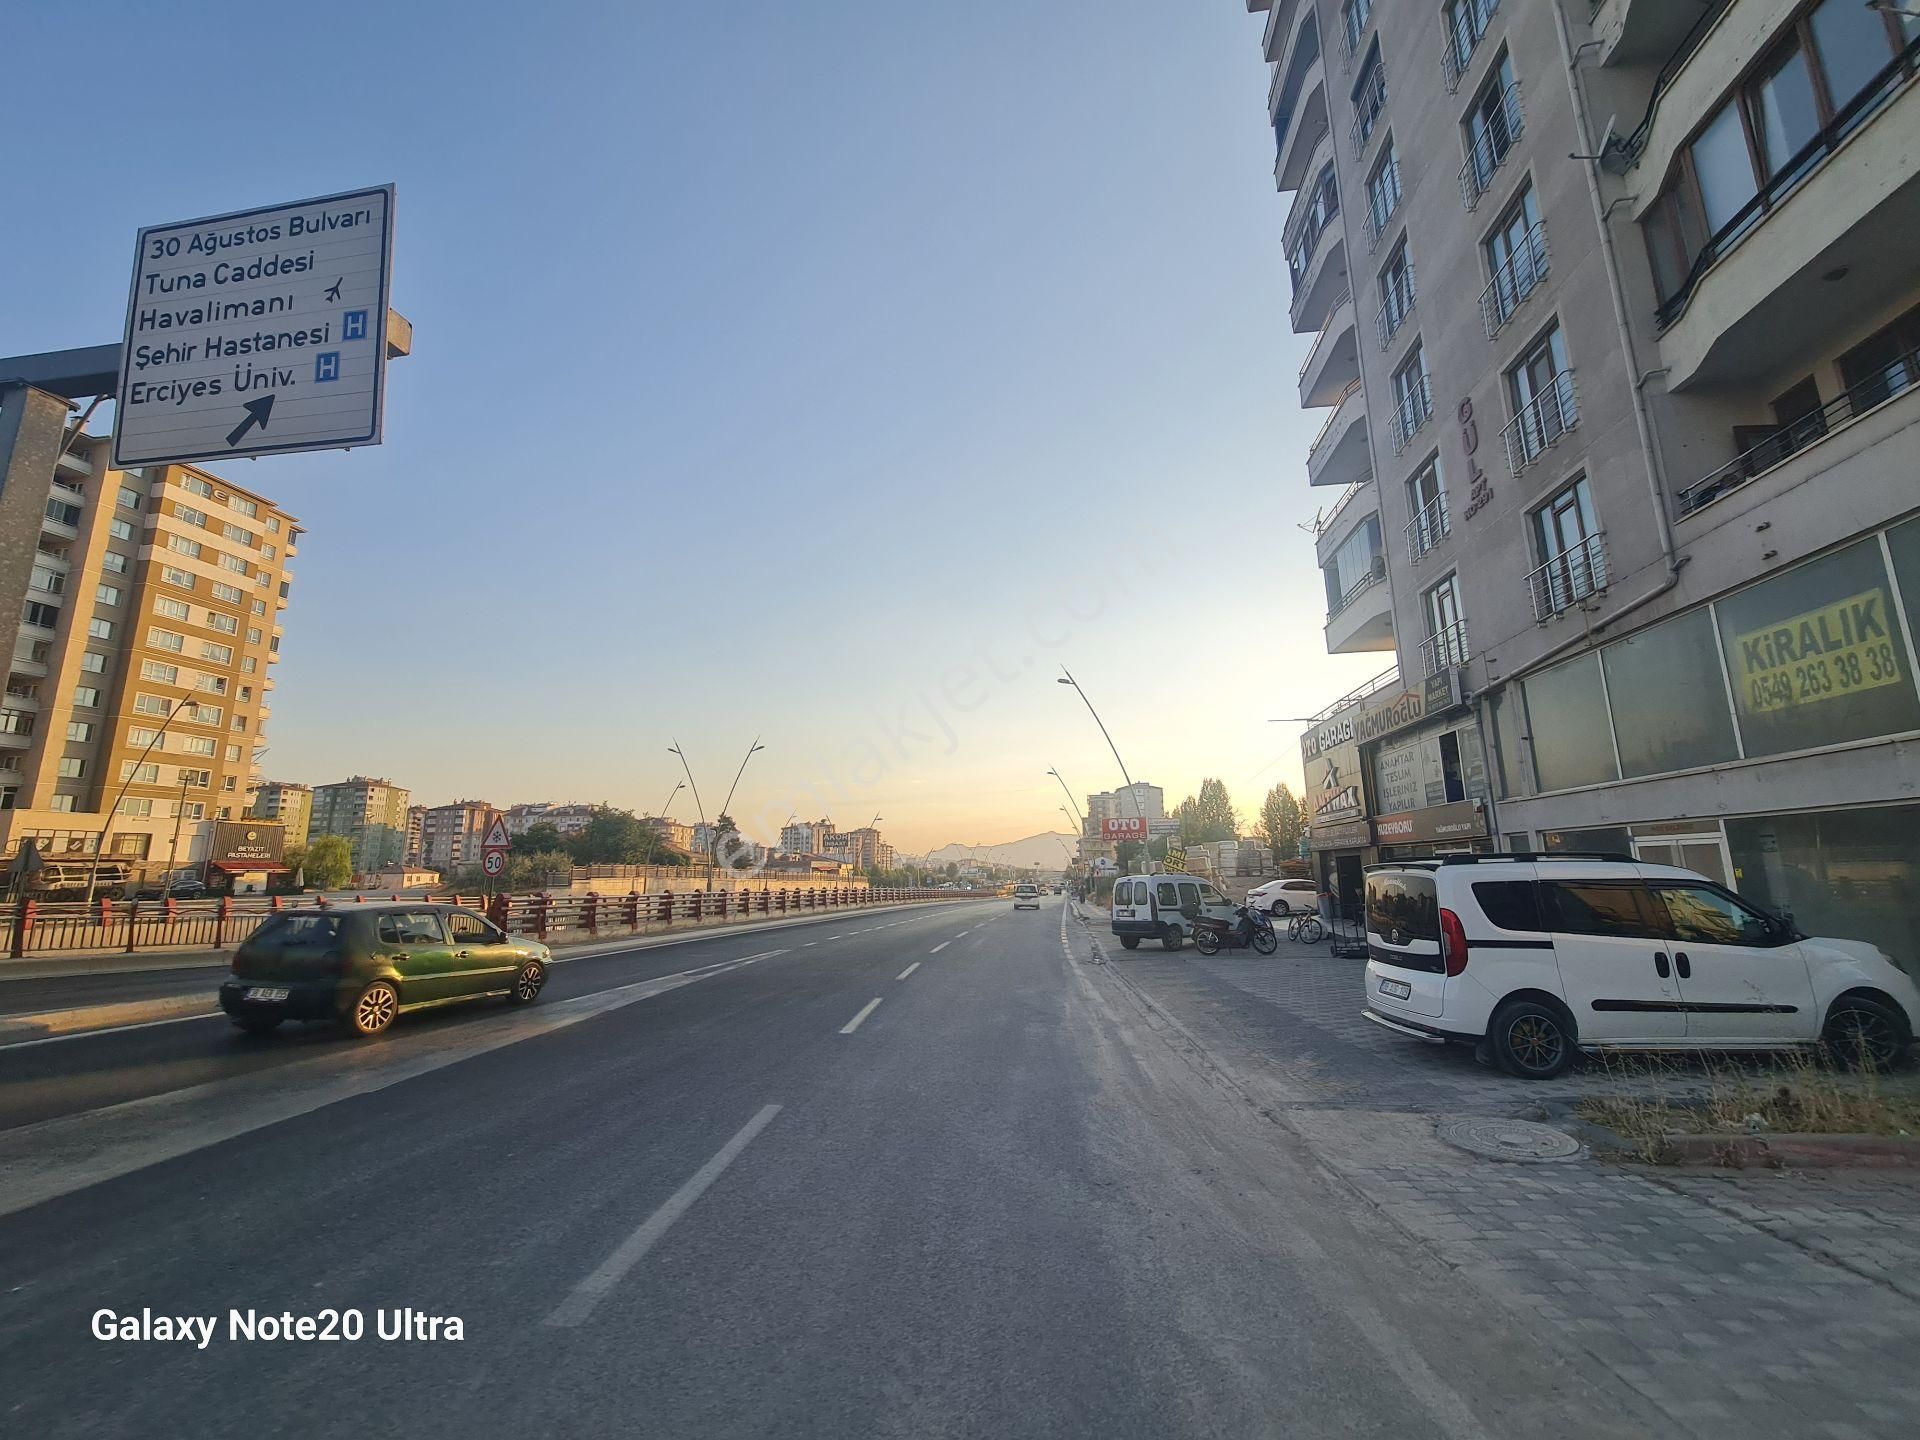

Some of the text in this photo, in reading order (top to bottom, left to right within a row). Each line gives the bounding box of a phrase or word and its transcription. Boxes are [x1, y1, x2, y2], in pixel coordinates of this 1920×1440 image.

[150, 210, 371, 260] 30 Ağustos Bulvarı
[145, 250, 315, 295] Tuna Caddesi
[139, 295, 294, 331] Havalimanı
[135, 342, 197, 371] Şehir
[205, 323, 330, 359] Hastanesi
[130, 378, 222, 406] Erciyes
[234, 362, 296, 392] Üniv.
[1750, 643, 1896, 707] 0549 263 38 38
[1427, 685, 1449, 702] MARKET
[1380, 751, 1415, 770] ANAHTAR
[823, 833, 848, 841] AKOR
[1103, 831, 1147, 840] GARAGE
[1108, 818, 1140, 831] OTO
[487, 856, 501, 869] 50
